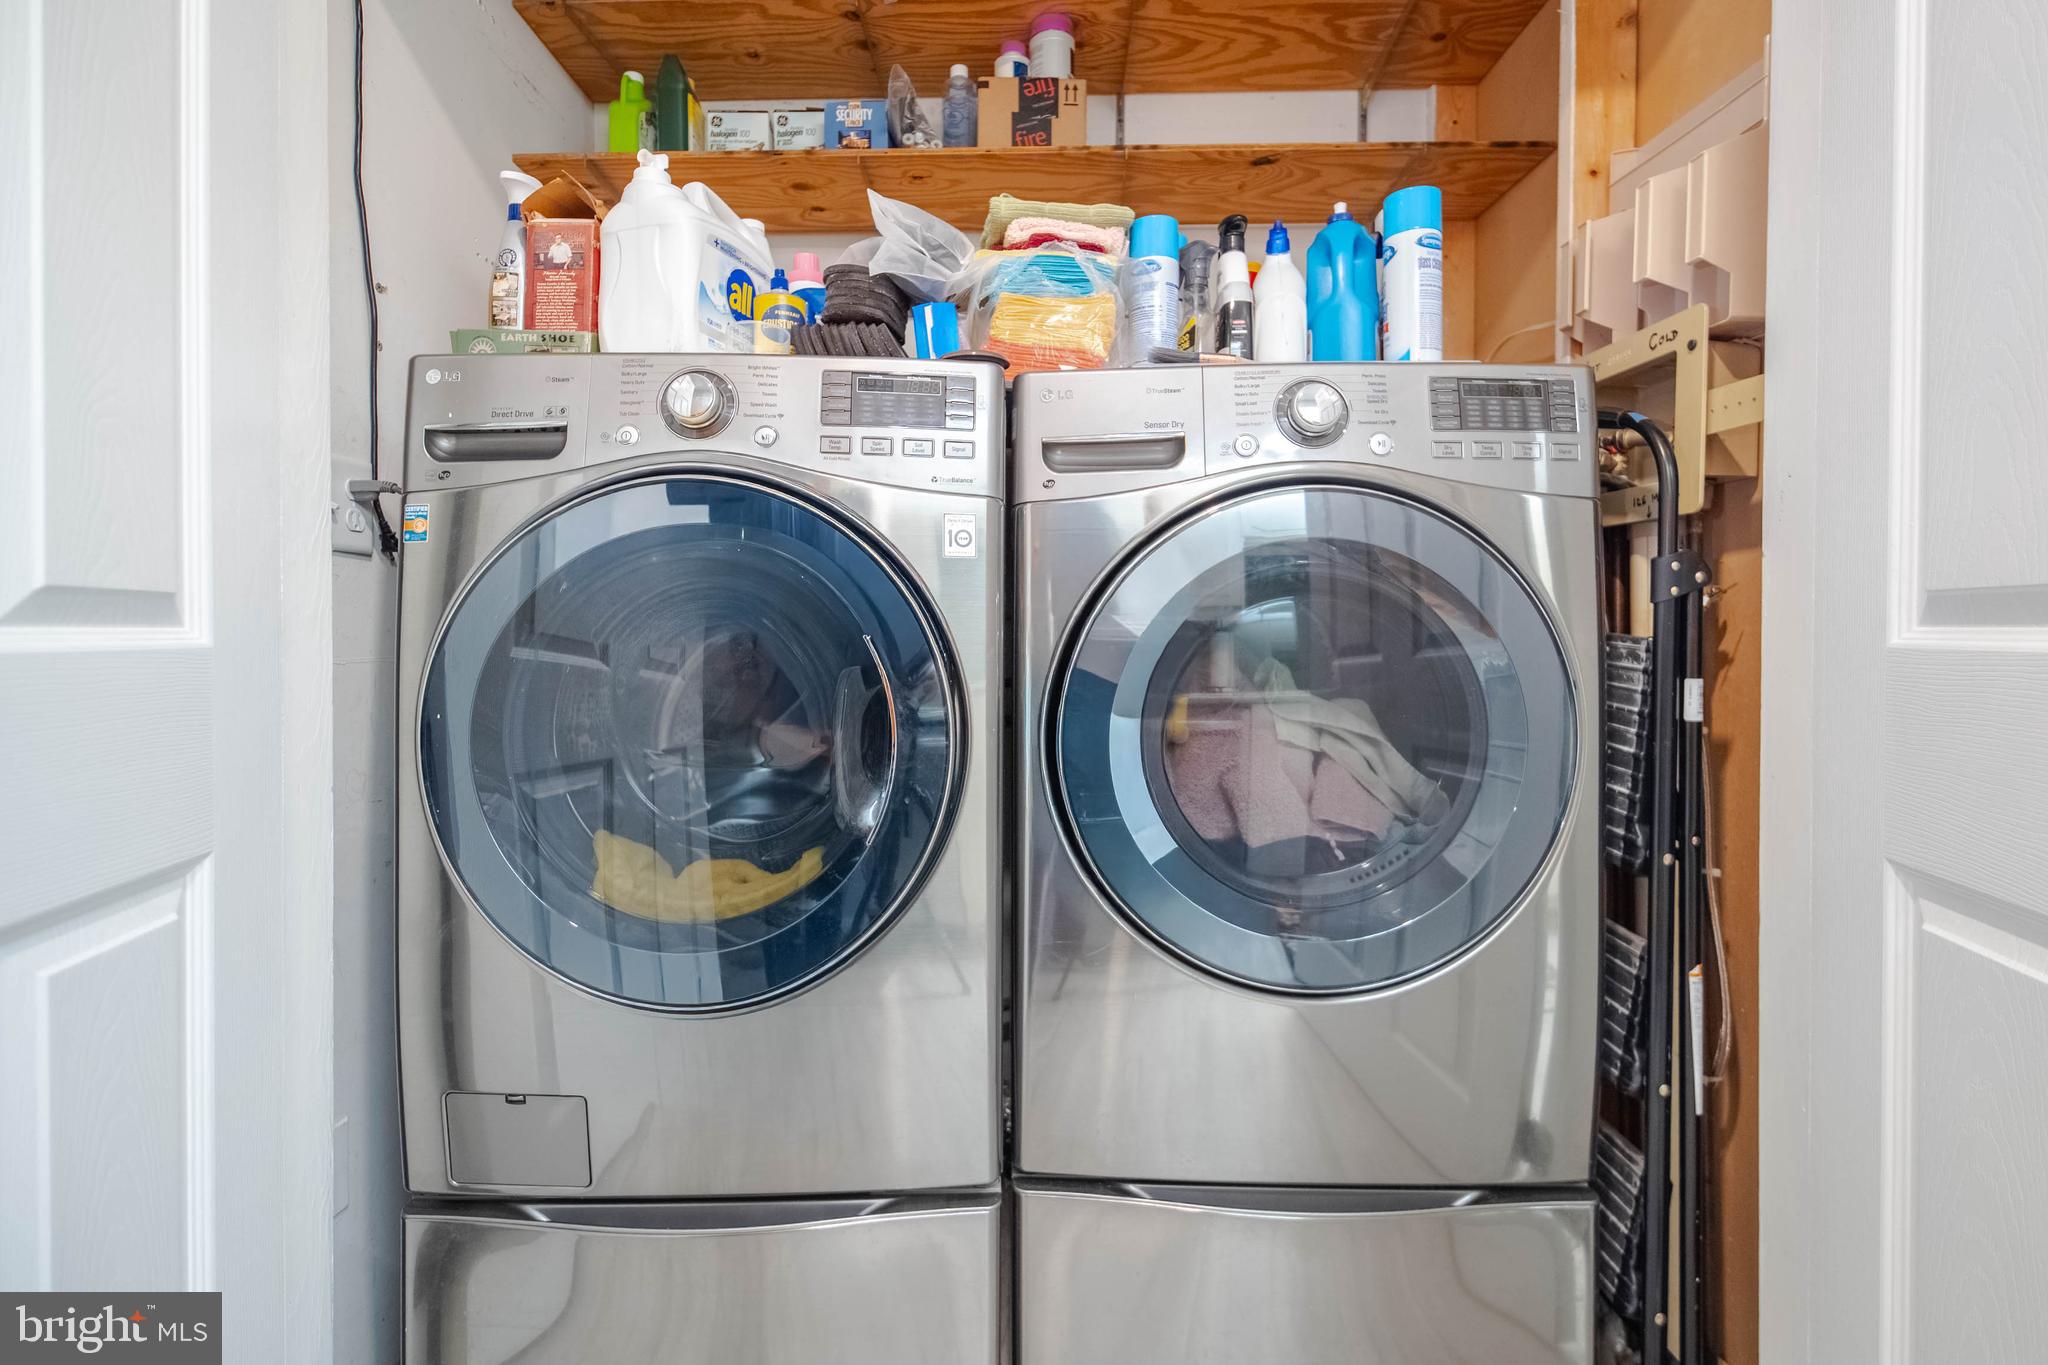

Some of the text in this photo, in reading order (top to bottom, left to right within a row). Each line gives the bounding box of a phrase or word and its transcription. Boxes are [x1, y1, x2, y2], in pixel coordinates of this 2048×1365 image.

[835, 108, 872, 122] SECURITY
[710, 129, 738, 139] halogen
[777, 129, 804, 138] halogen
[1015, 130, 1048, 145] fire
[729, 282, 753, 318] all
[501, 333, 575, 343] EARTH SHOE
[1648, 329, 1679, 351] COLD
[444, 371, 461, 382] LG
[1057, 390, 1074, 400] LG
[491, 409, 534, 418] Direct Drive
[1144, 419, 1185, 430] Sensor Dry
[947, 529, 973, 548] 10
